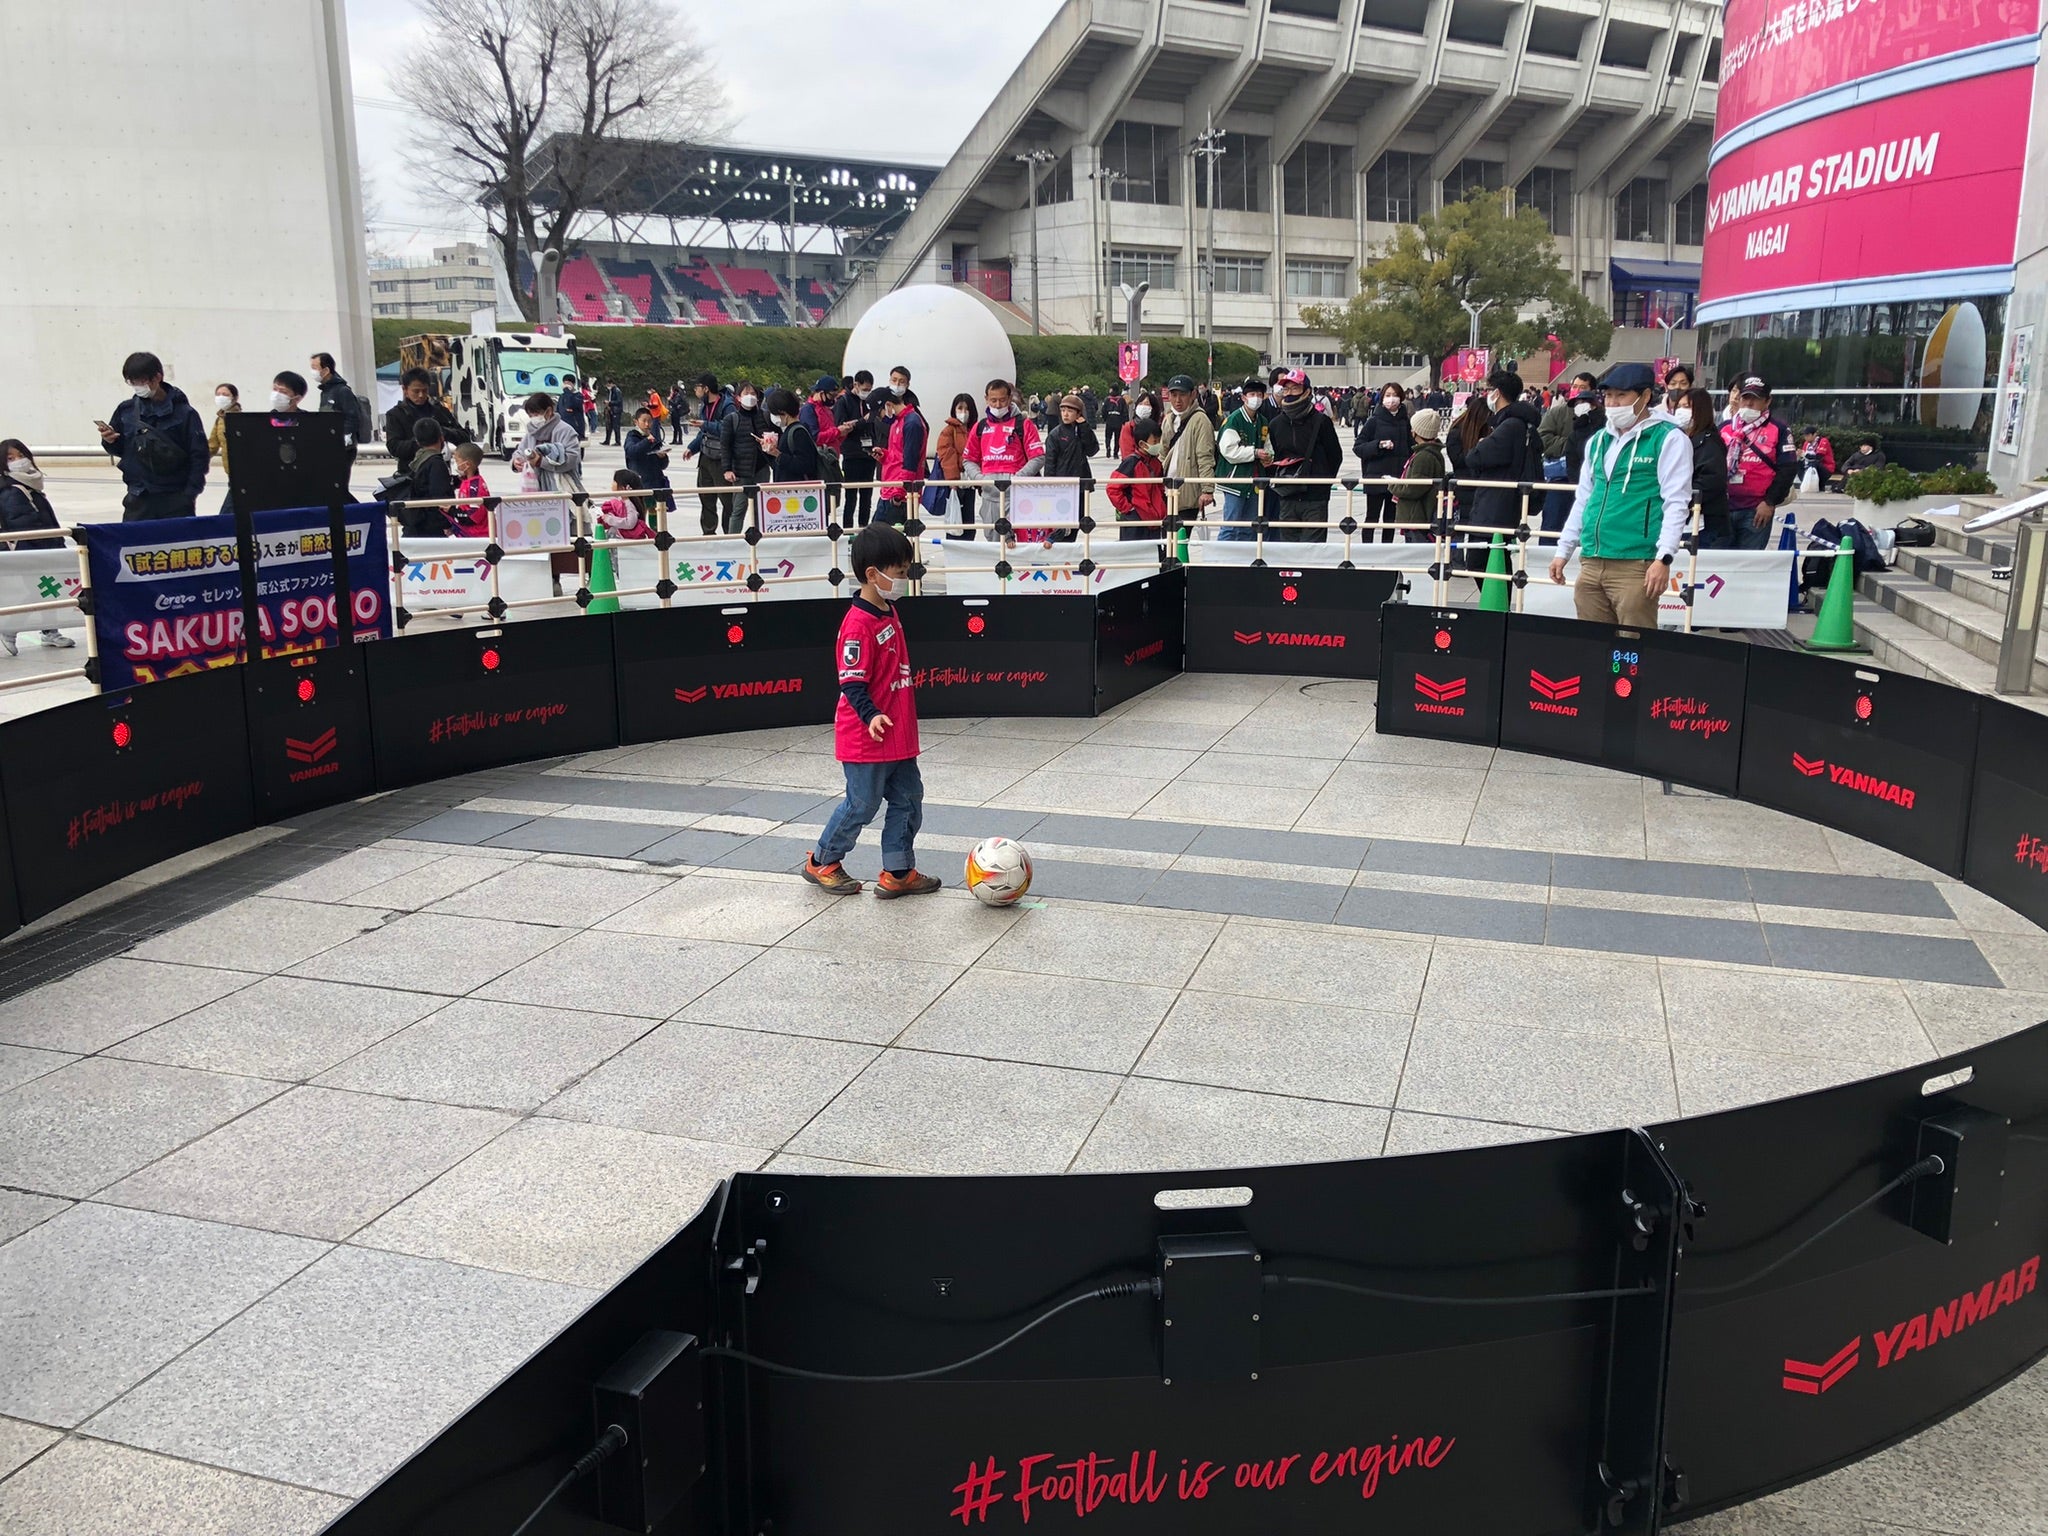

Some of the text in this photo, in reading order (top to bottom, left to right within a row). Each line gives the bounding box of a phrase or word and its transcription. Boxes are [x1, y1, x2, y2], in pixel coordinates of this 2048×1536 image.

[1718, 132, 1941, 225] YANMAR STADIUM
[1744, 223, 1790, 260] NAGAI
[1632, 456, 1655, 464] TAFF
[126, 603, 274, 657] SAKURA
[1265, 630, 1347, 649] YANMAR
[1134, 639, 1164, 664] YANMAR
[1612, 650, 1639, 664] 0:40
[710, 677, 803, 700] YANMAR
[971, 669, 984, 683] is
[986, 671, 1005, 682] our
[1006, 669, 1048, 688] engine
[488, 712, 502, 728] is
[505, 709, 524, 722] our
[525, 702, 568, 725] engine
[1414, 702, 1465, 717] YANMAR
[1528, 700, 1580, 718] YANMAR
[1698, 701, 1710, 715] is
[1669, 717, 1732, 740] our engine
[289, 762, 339, 783] YANMAR
[1829, 764, 1915, 808] YANMAR
[125, 801, 138, 820] is
[140, 793, 160, 811] our
[161, 779, 204, 810] engine
[773, 1196, 783, 1208] 7
[1873, 1254, 2041, 1369] YANMAR
[1177, 1458, 1226, 1501] is
[1233, 1453, 1298, 1493] our
[1308, 1433, 1457, 1500] engine
